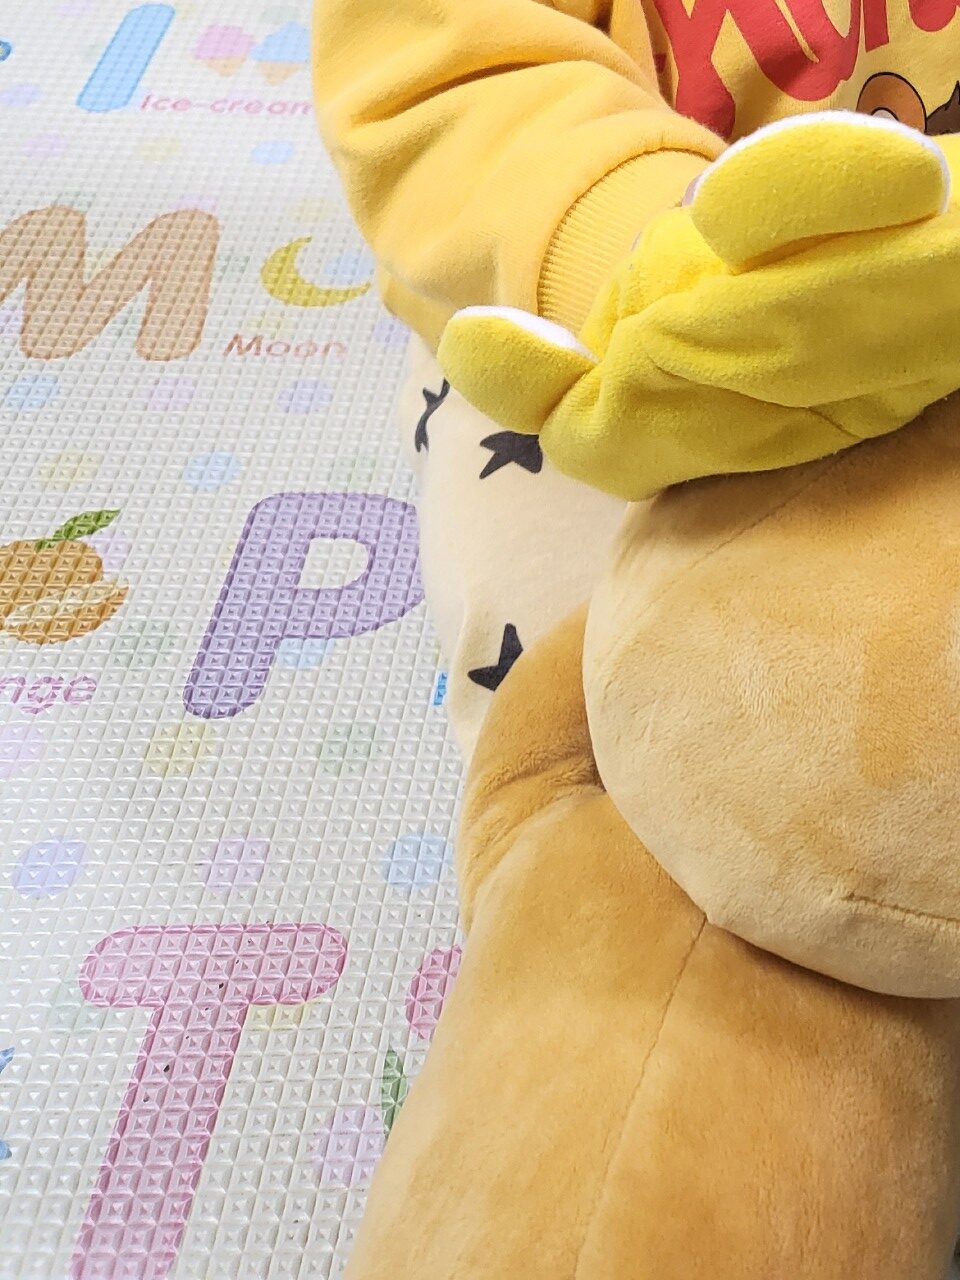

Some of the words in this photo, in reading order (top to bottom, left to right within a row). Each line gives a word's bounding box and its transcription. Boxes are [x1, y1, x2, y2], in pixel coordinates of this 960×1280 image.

[0, 205, 220, 362] M
[222, 332, 348, 358] Moon
[182, 492, 426, 719] P
[69, 923, 348, 1280] T
